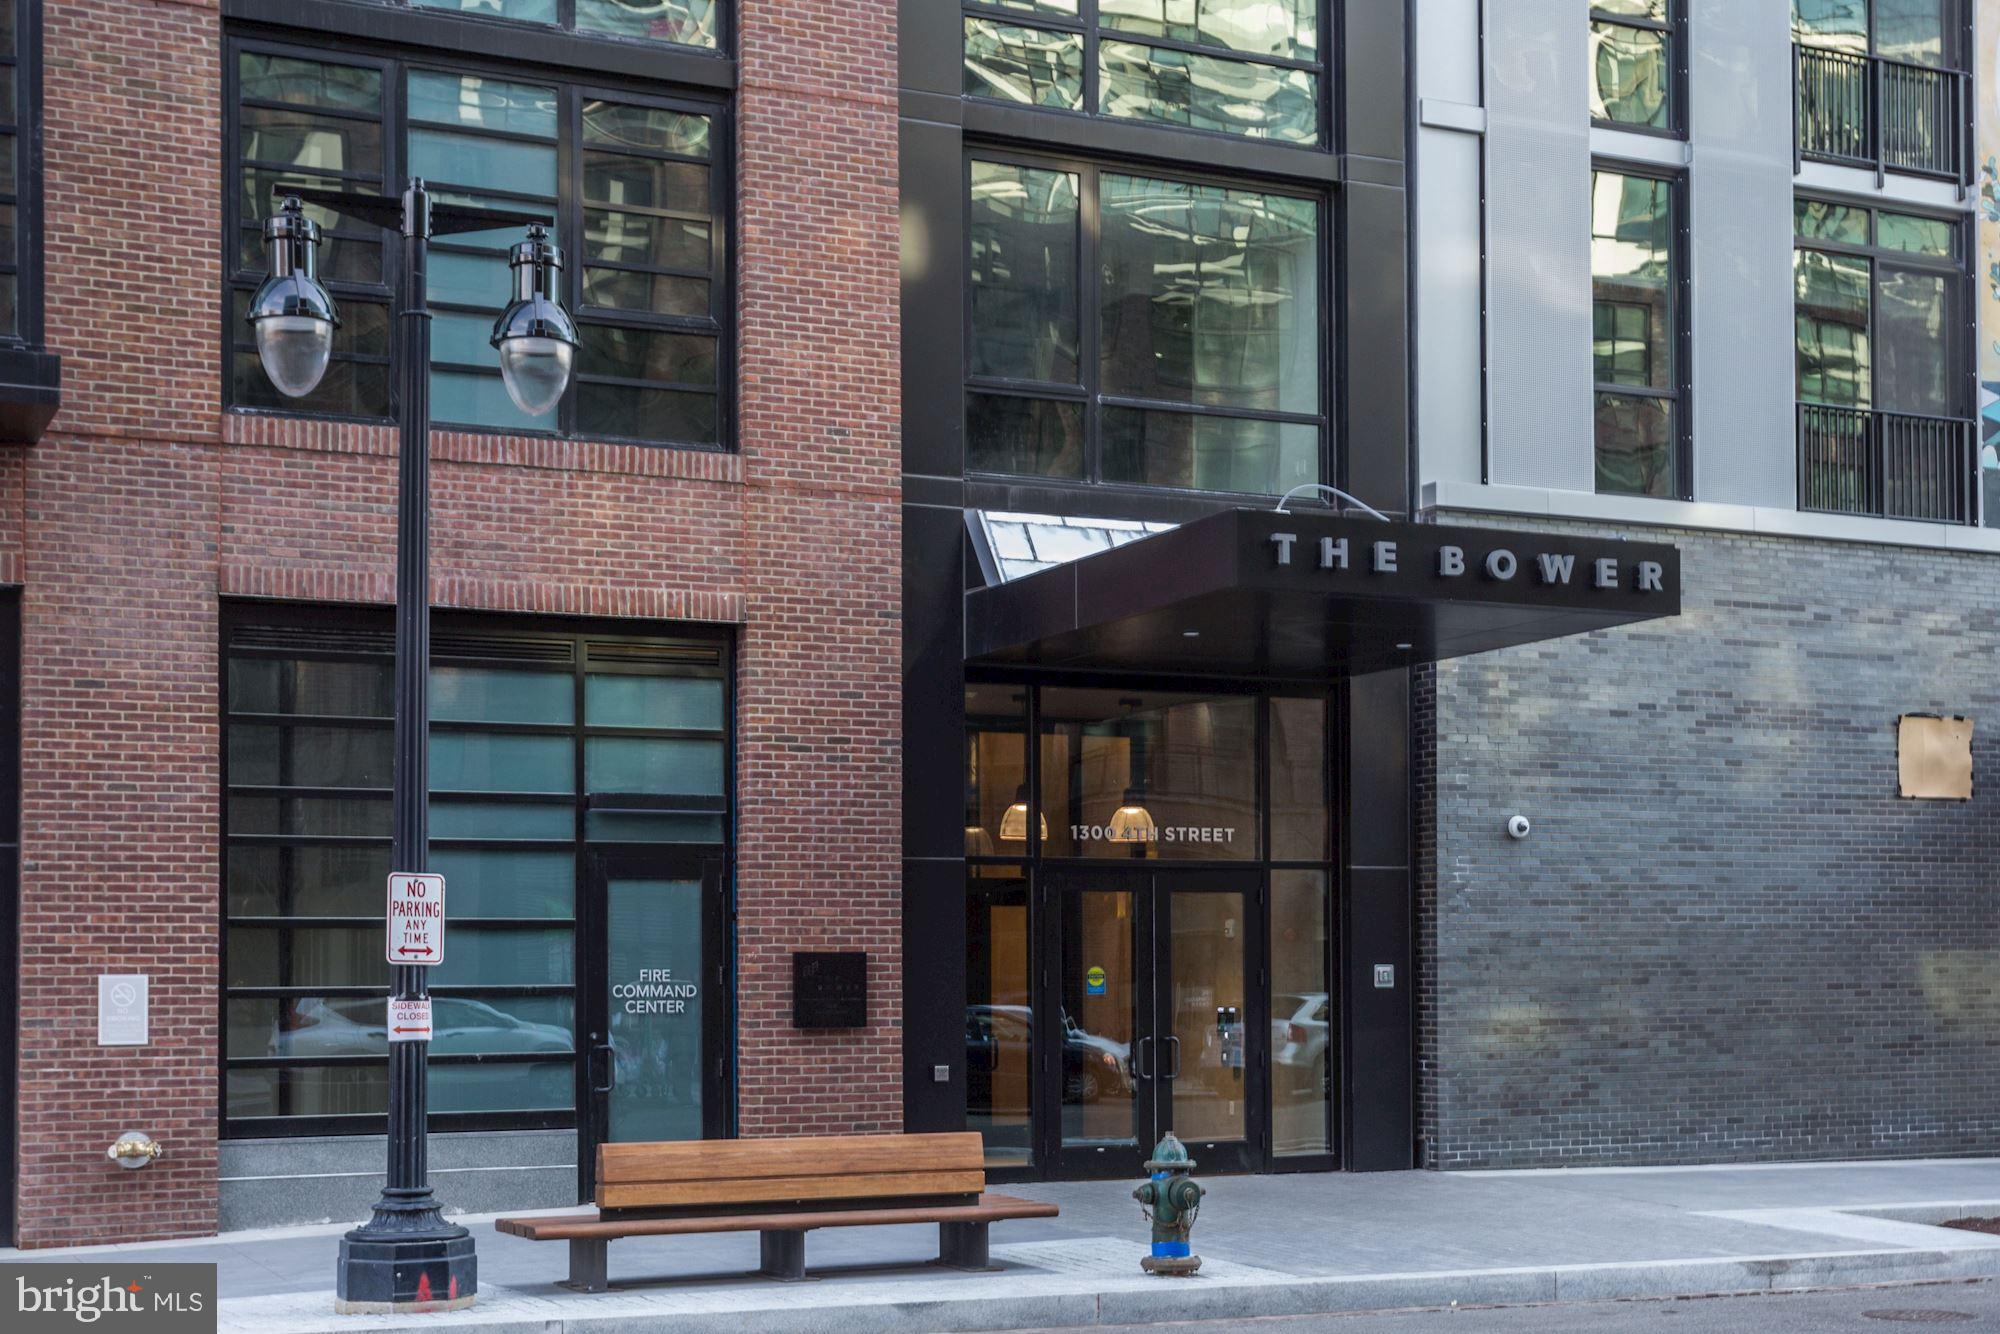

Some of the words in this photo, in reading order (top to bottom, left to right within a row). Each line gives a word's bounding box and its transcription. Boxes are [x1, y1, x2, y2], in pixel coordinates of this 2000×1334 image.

[1270, 532, 1397, 573] THE
[1438, 545, 1663, 592] BOWER
[1070, 824, 1117, 840] 1300
[1165, 827, 1235, 843] STREET
[407, 881, 426, 898] NO
[392, 900, 440, 918] PARKING
[405, 919, 427, 931] ANY
[403, 932, 429, 944] TIME
[639, 968, 671, 983] FIRE
[612, 984, 697, 998] COMMAND
[625, 1000, 685, 1014] CENTER
